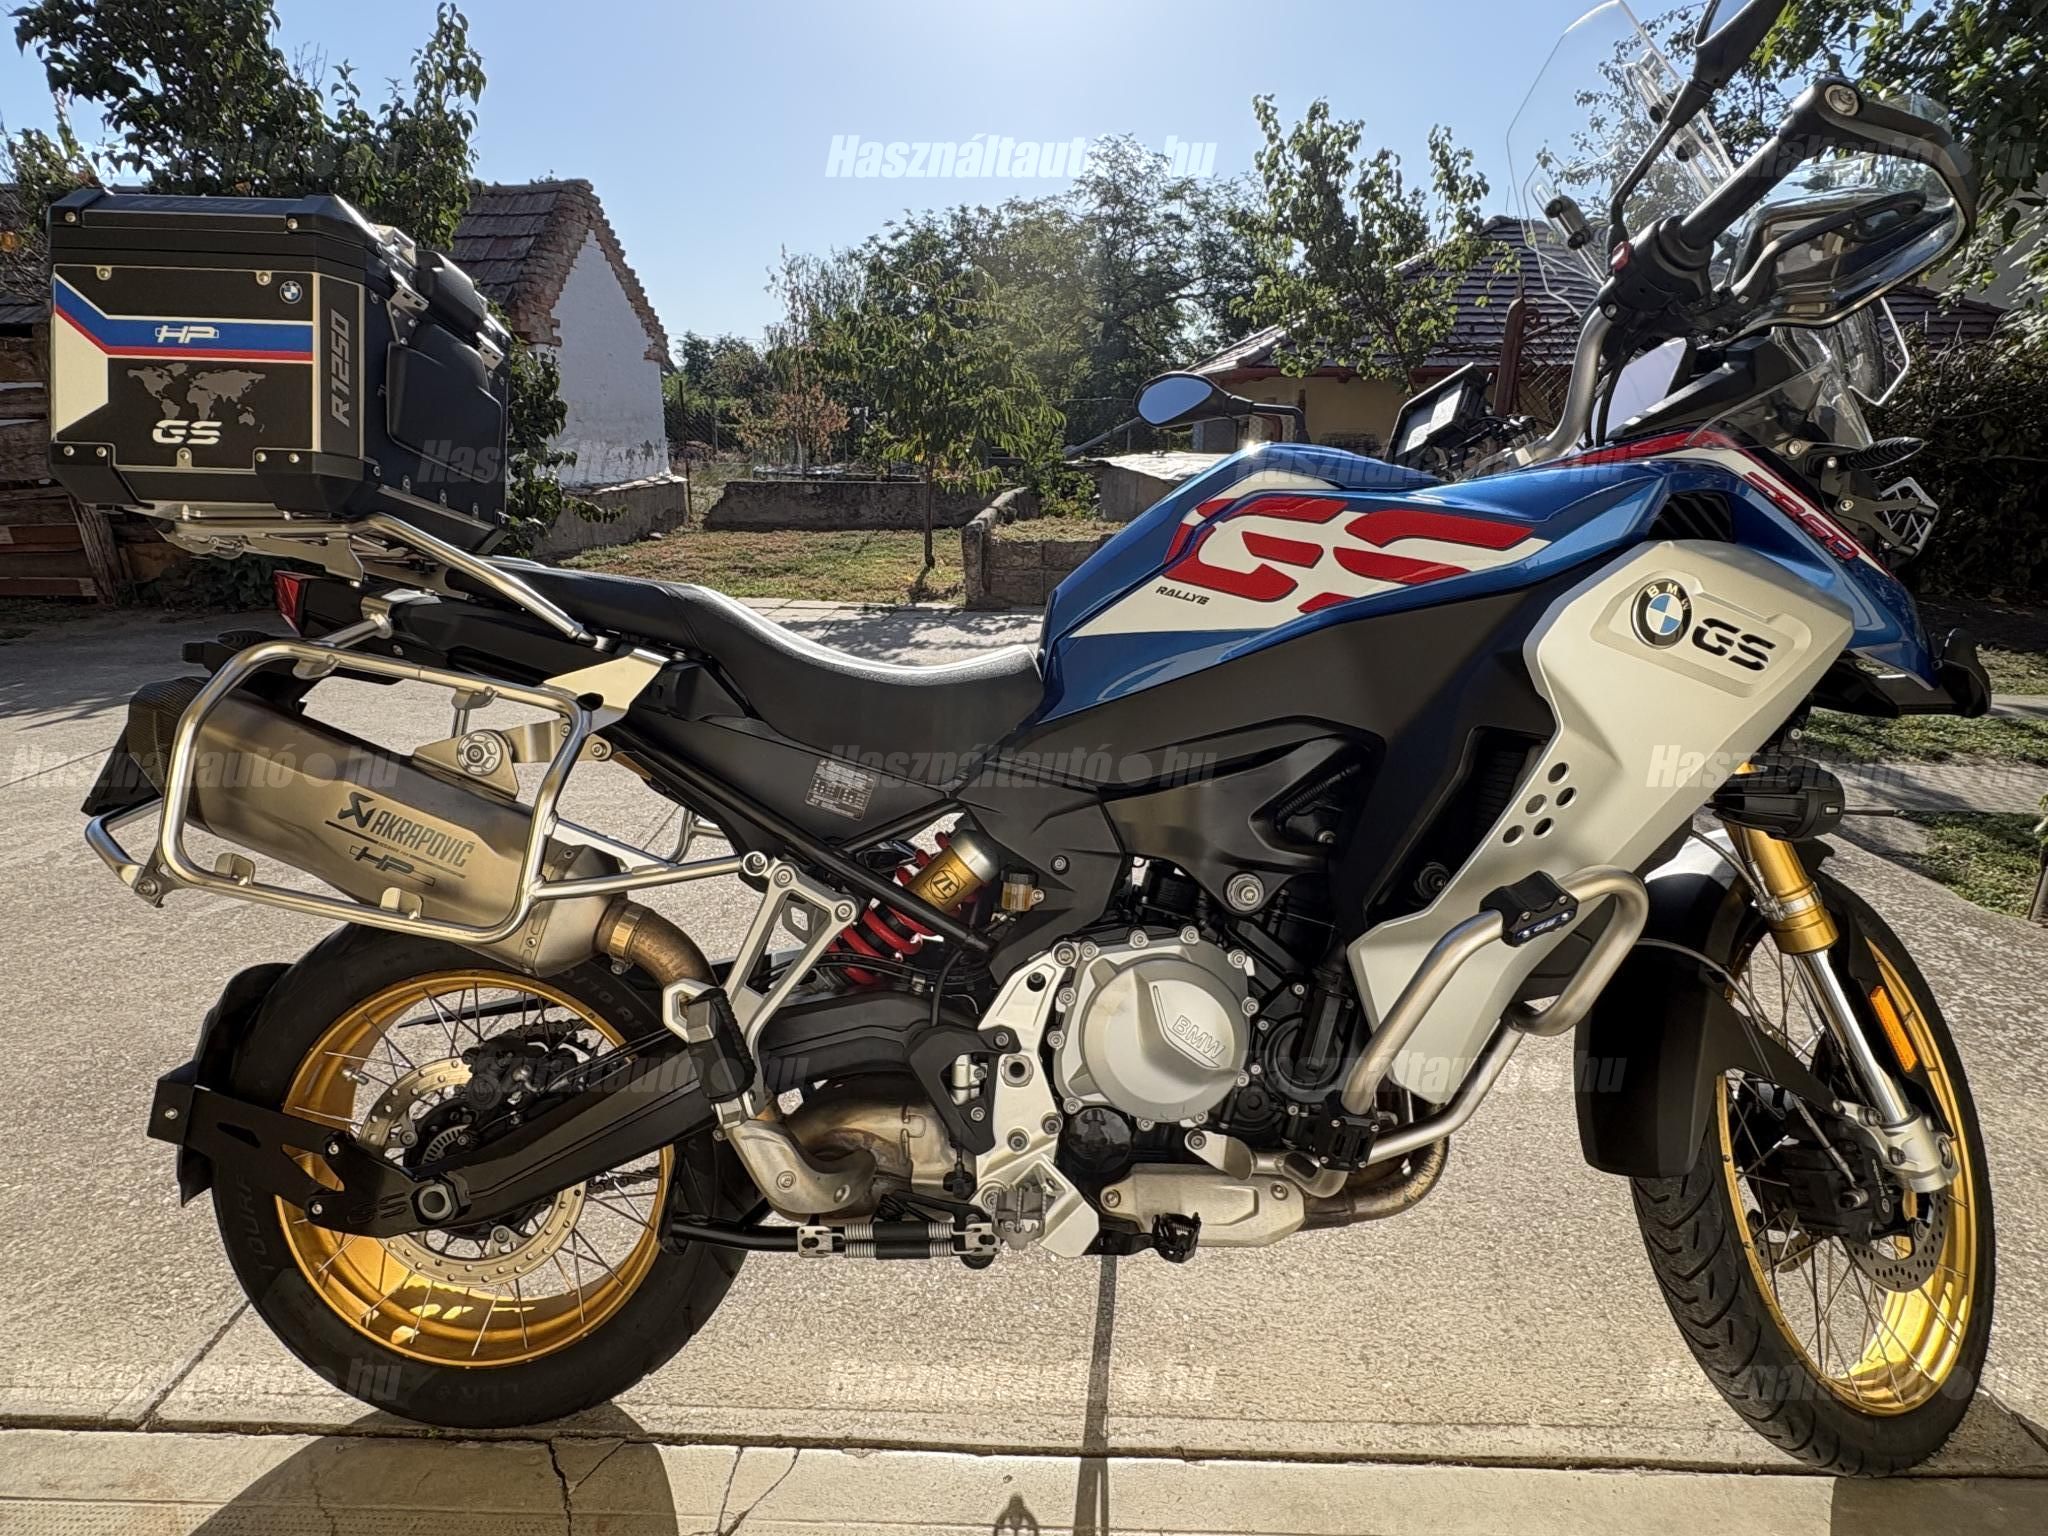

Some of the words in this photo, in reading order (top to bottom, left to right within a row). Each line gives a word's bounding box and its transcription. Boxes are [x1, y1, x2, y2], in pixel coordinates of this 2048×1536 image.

[156, 325, 217, 344] HP
[331, 308, 350, 428] R1250
[152, 419, 222, 444] GS
[1162, 496, 1535, 614] GS
[1646, 582, 1691, 611] BMW
[1692, 617, 1776, 671] GS
[370, 810, 476, 868] AKRAPOVIČ
[1172, 1014, 1226, 1059] BMW
